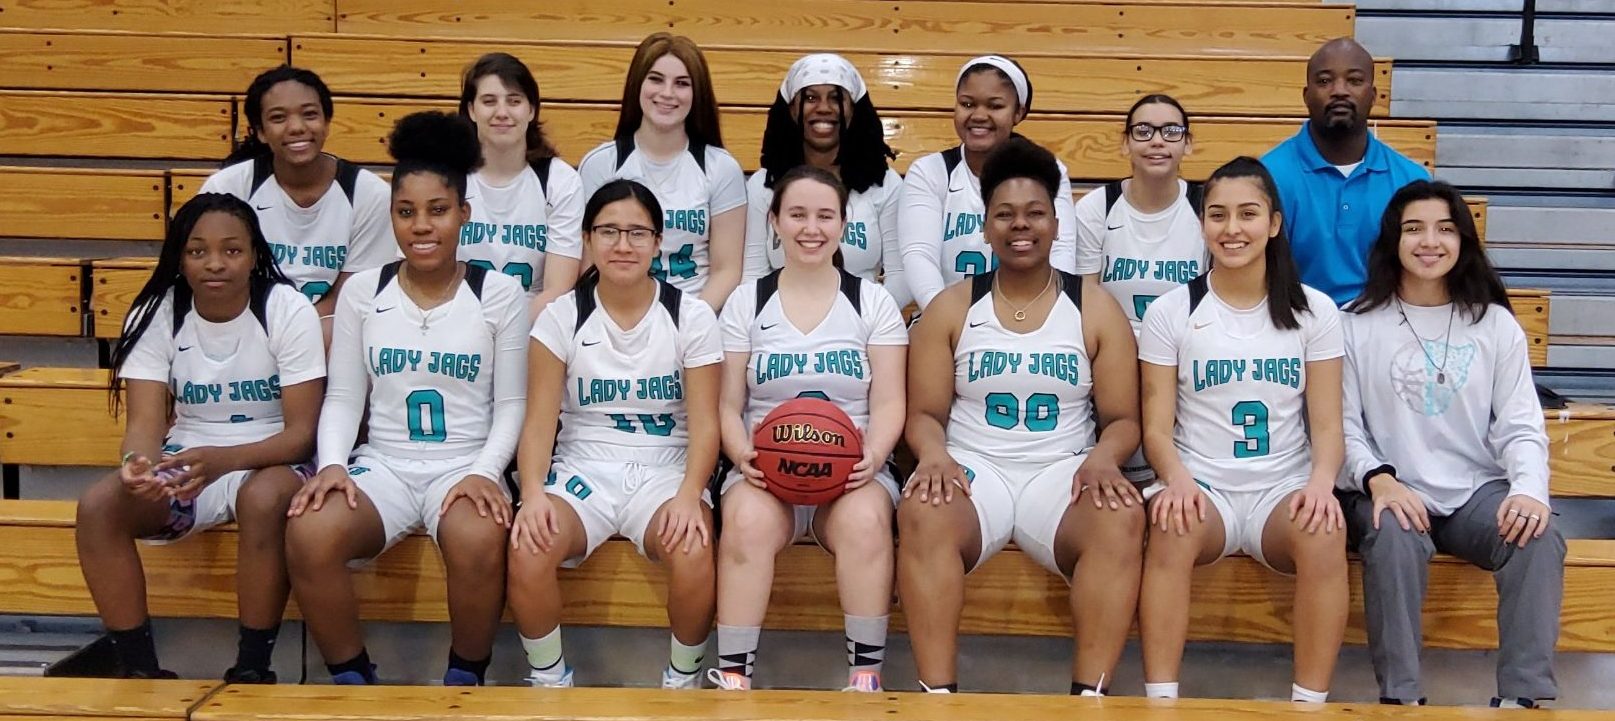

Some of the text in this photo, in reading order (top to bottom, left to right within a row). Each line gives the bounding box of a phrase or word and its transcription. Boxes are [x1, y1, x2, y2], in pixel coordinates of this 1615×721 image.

[460, 221, 547, 253] ADY JAGS
[664, 209, 706, 236] JAGS
[840, 221, 867, 250] GS
[302, 245, 347, 270] JAGS
[1102, 255, 1200, 285] LADY JAGS
[368, 346, 482, 383] LADY JAGS
[756, 349, 864, 385] LADY JAGS
[968, 351, 1079, 386] LADY JAGS
[1193, 358, 1301, 392] LADY JAGS
[172, 374, 282, 405] LADY JAGS
[577, 369, 683, 407] LADY JAGS
[405, 389, 447, 443] 0
[1231, 400, 1270, 459] 3
[772, 422, 846, 449] Wilson
[777, 457, 834, 478] NCAA
